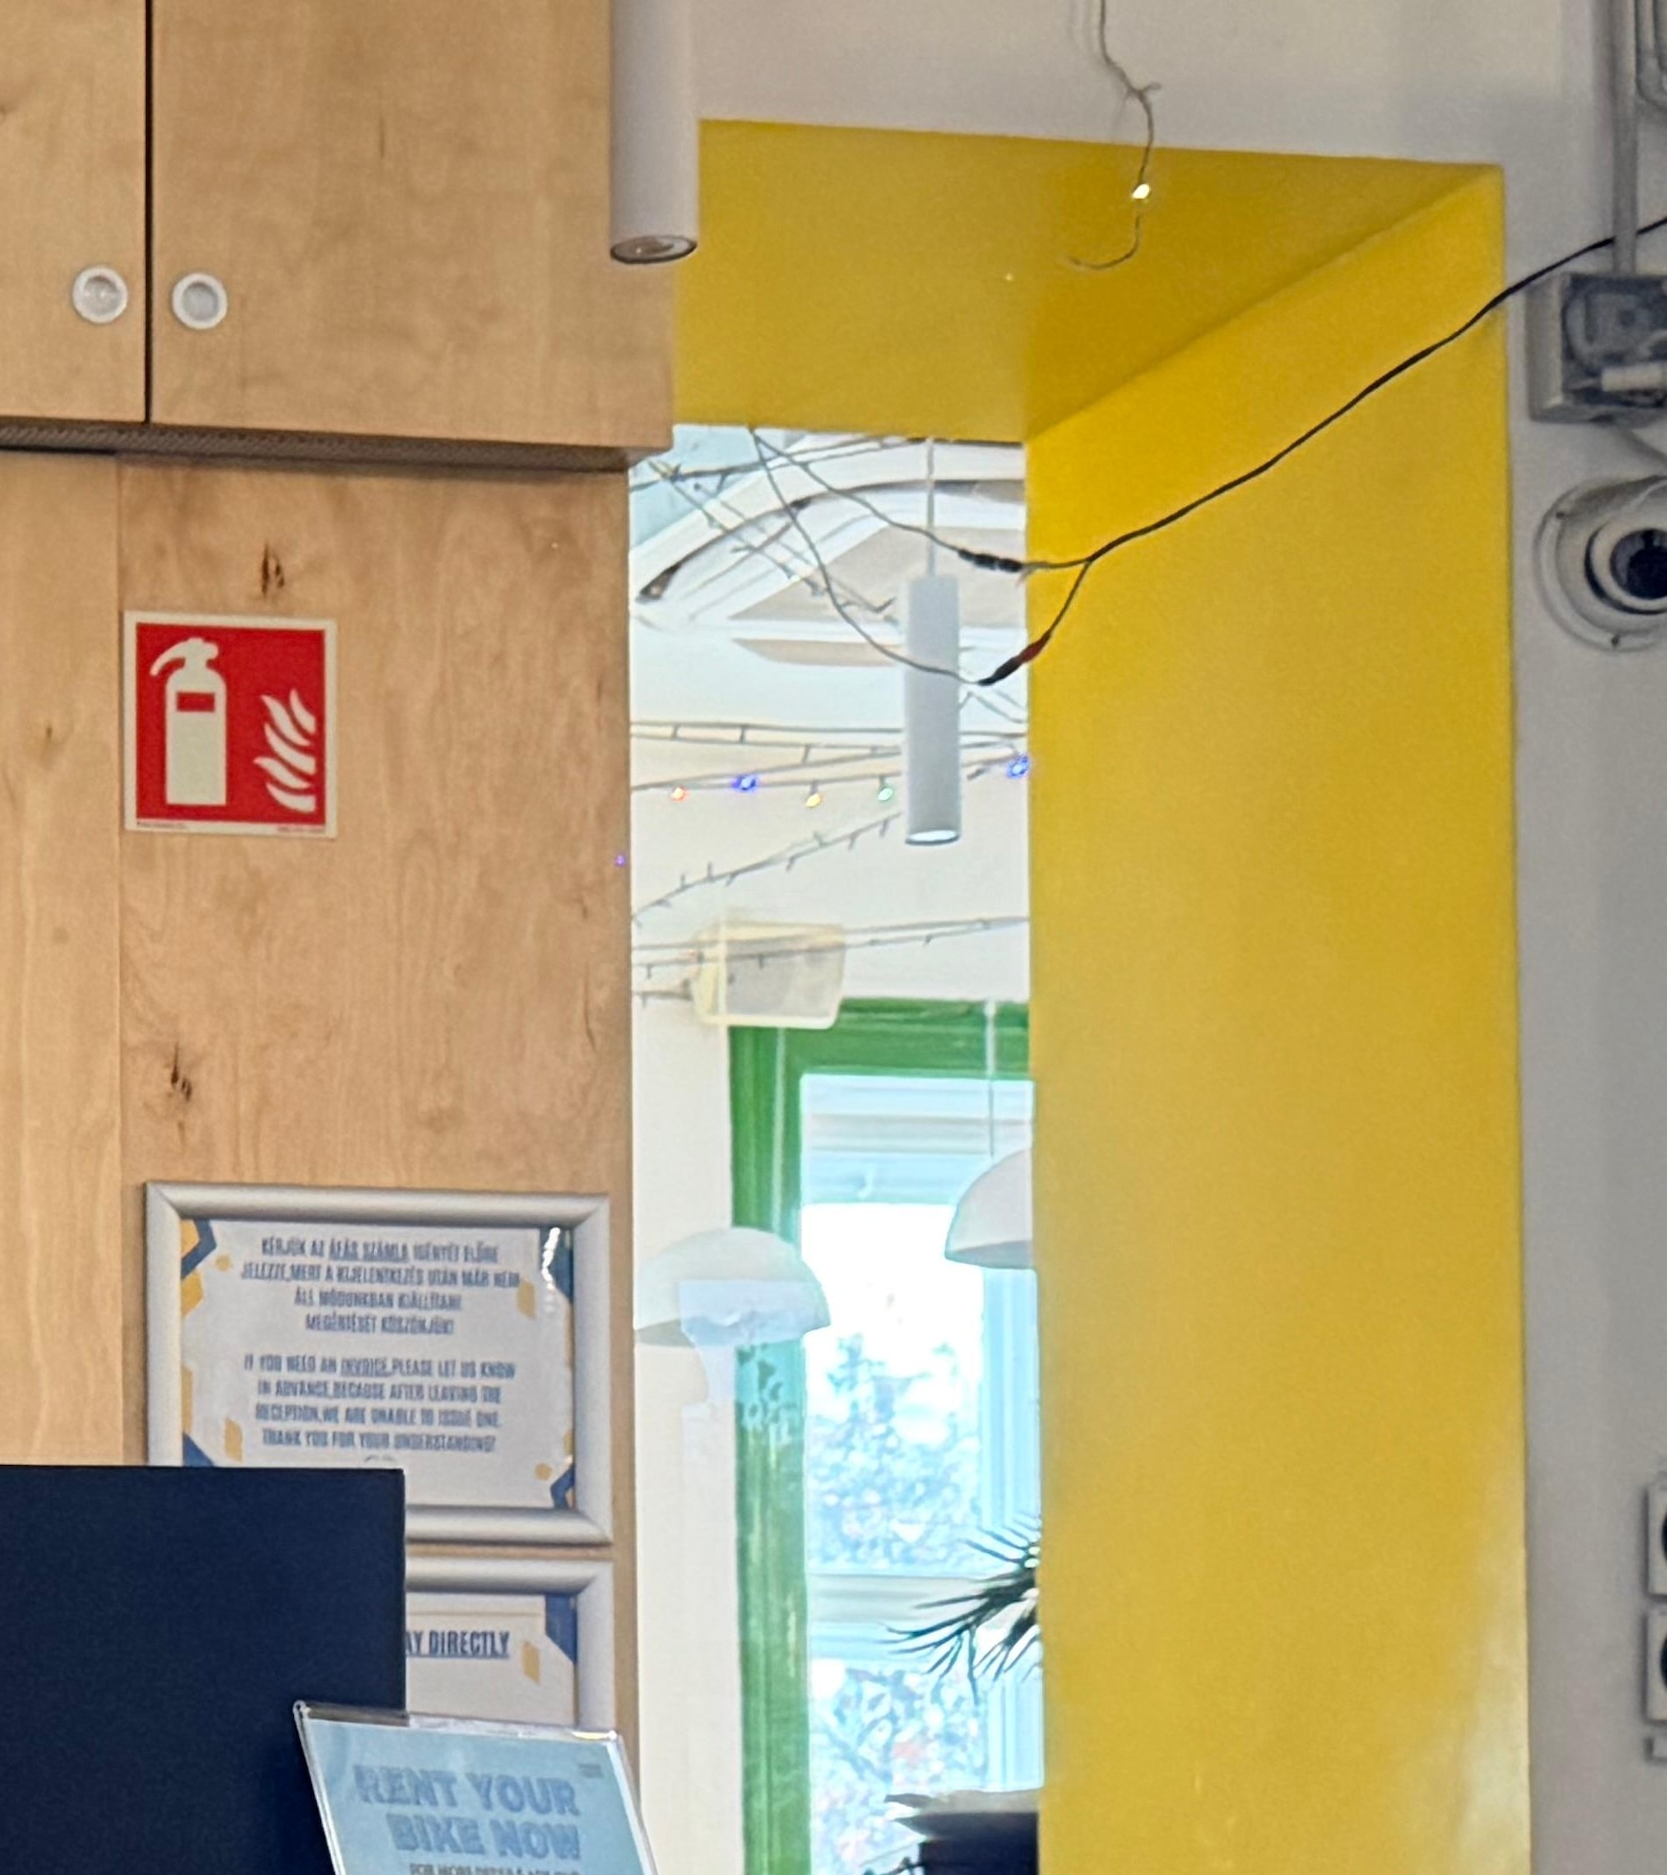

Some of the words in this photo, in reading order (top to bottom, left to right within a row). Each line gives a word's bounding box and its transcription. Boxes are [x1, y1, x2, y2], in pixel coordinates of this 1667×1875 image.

[428, 1629, 510, 1657] DIRECTLY
[353, 1764, 458, 1808] RENT
[466, 1771, 581, 1817] YOUR
[386, 1813, 485, 1855] BIKE
[489, 1818, 581, 1861] NOW
